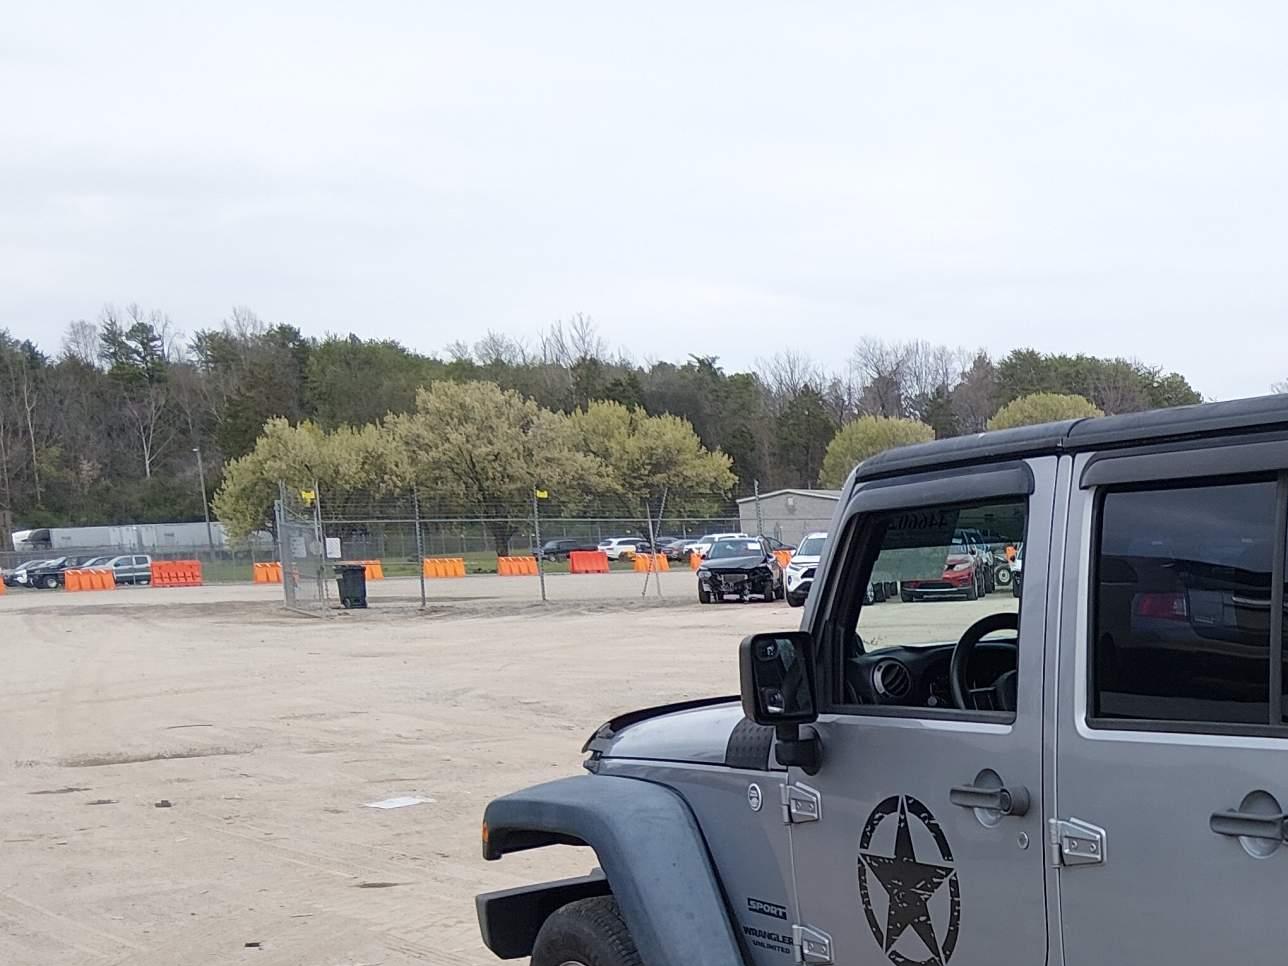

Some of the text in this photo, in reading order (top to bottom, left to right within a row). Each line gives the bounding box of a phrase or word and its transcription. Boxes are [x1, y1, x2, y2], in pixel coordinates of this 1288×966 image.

[748, 900, 786, 918] SPORT
[743, 926, 793, 946] WRANGLER
[752, 939, 791, 954] UNLIMITED
